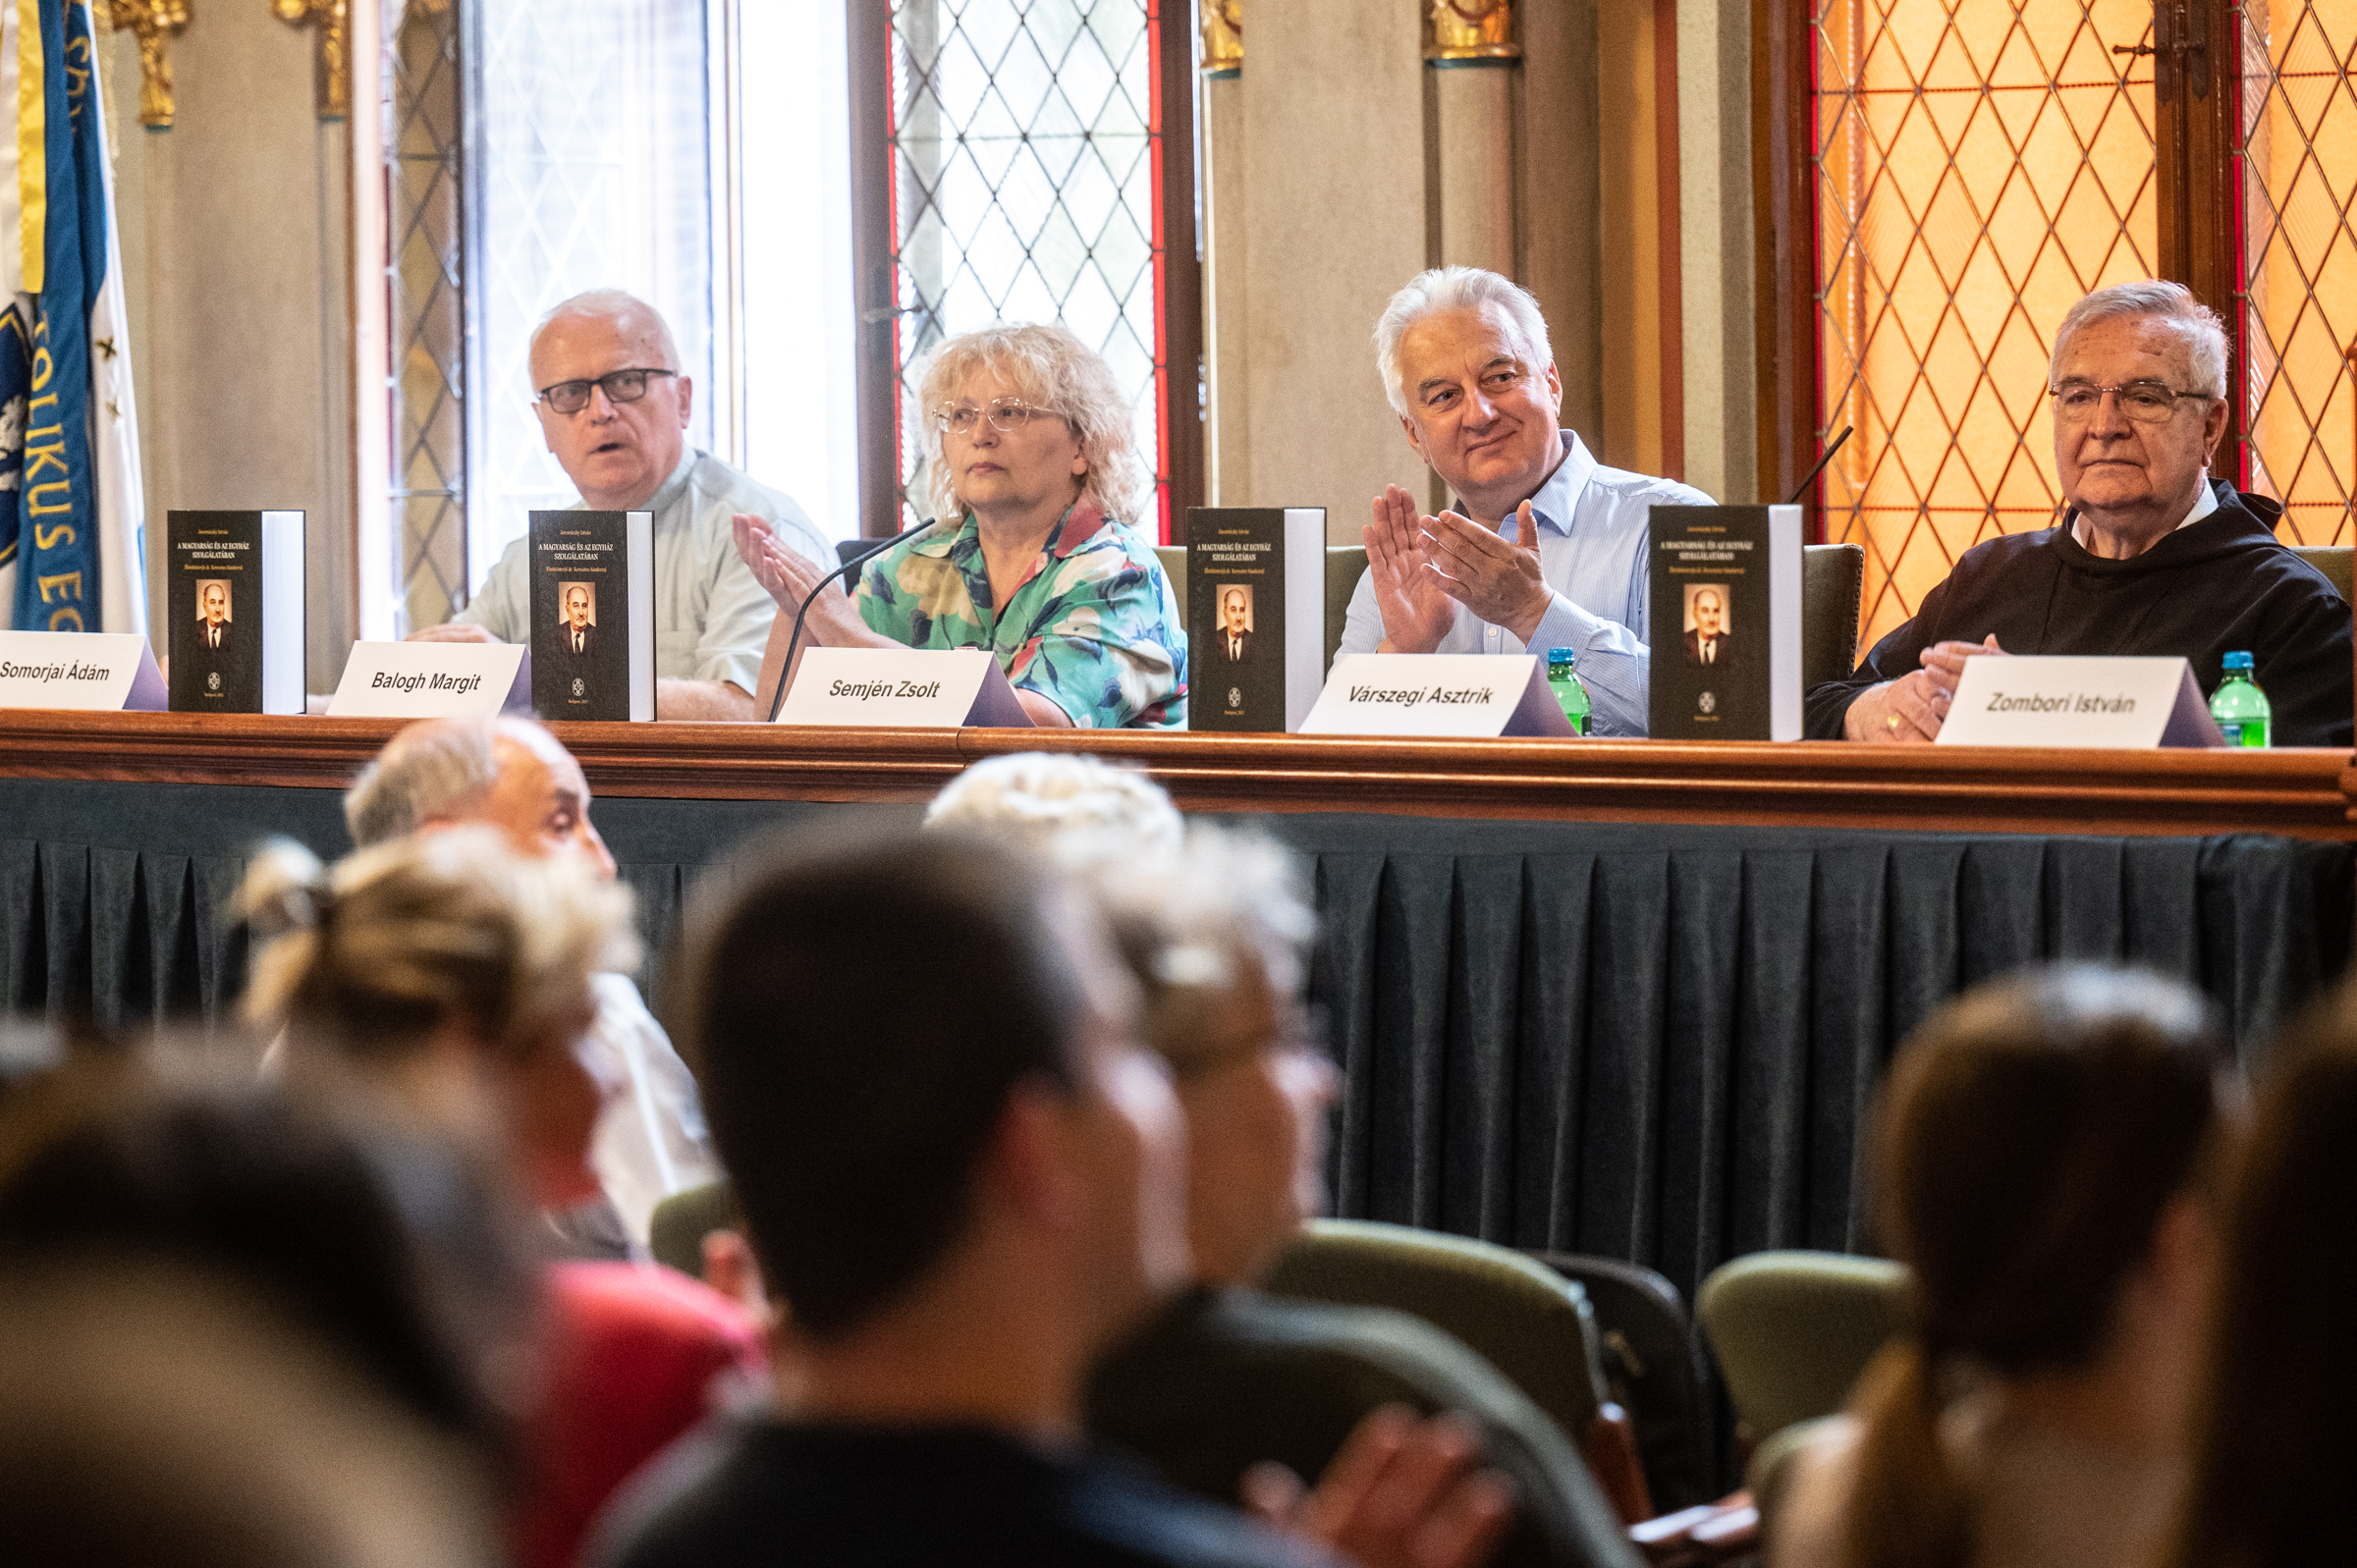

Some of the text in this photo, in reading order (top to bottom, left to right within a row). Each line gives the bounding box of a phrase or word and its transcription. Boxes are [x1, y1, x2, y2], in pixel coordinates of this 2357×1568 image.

[543, 542, 576, 551] MAGYARSÁG
[576, 542, 584, 551] ÉS
[592, 542, 614, 551] EGYHÁZ
[553, 552, 599, 561] SZOLGÁLATÁBAN
[0, 659, 110, 683] Somorjai Ádám
[371, 672, 482, 694] Balogh Margit
[829, 678, 941, 701] Semjén Zsolt
[1348, 685, 1494, 708] Várszegi Asztrik
[1986, 691, 2136, 713] Zombori István
